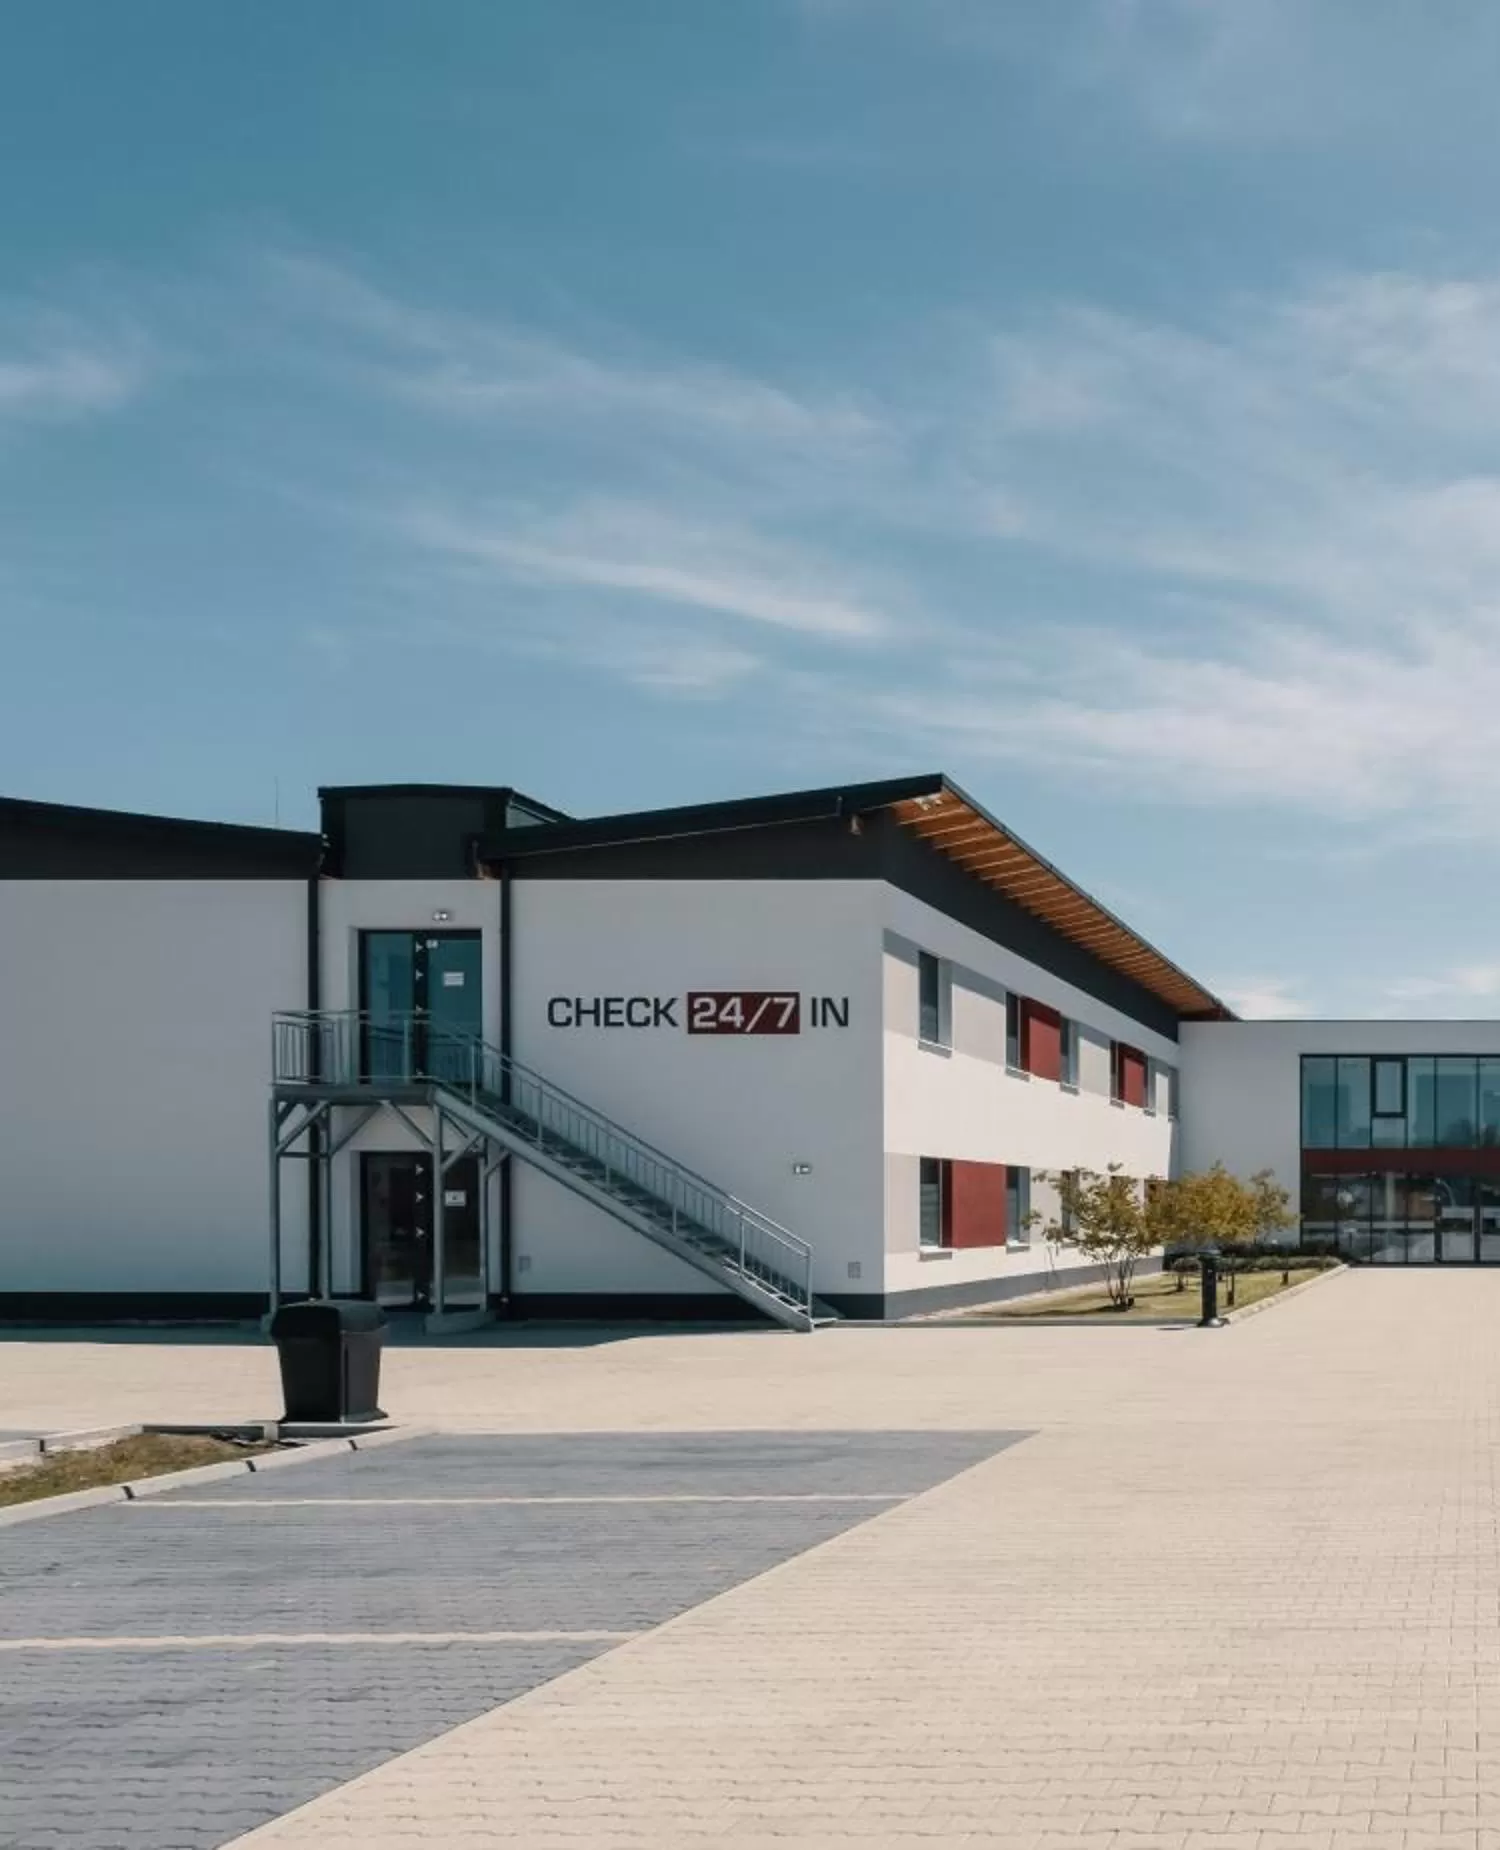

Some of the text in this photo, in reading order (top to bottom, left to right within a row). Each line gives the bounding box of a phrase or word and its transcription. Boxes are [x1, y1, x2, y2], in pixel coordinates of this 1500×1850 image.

[547, 996, 849, 1032] CHECK 24/7 IN
